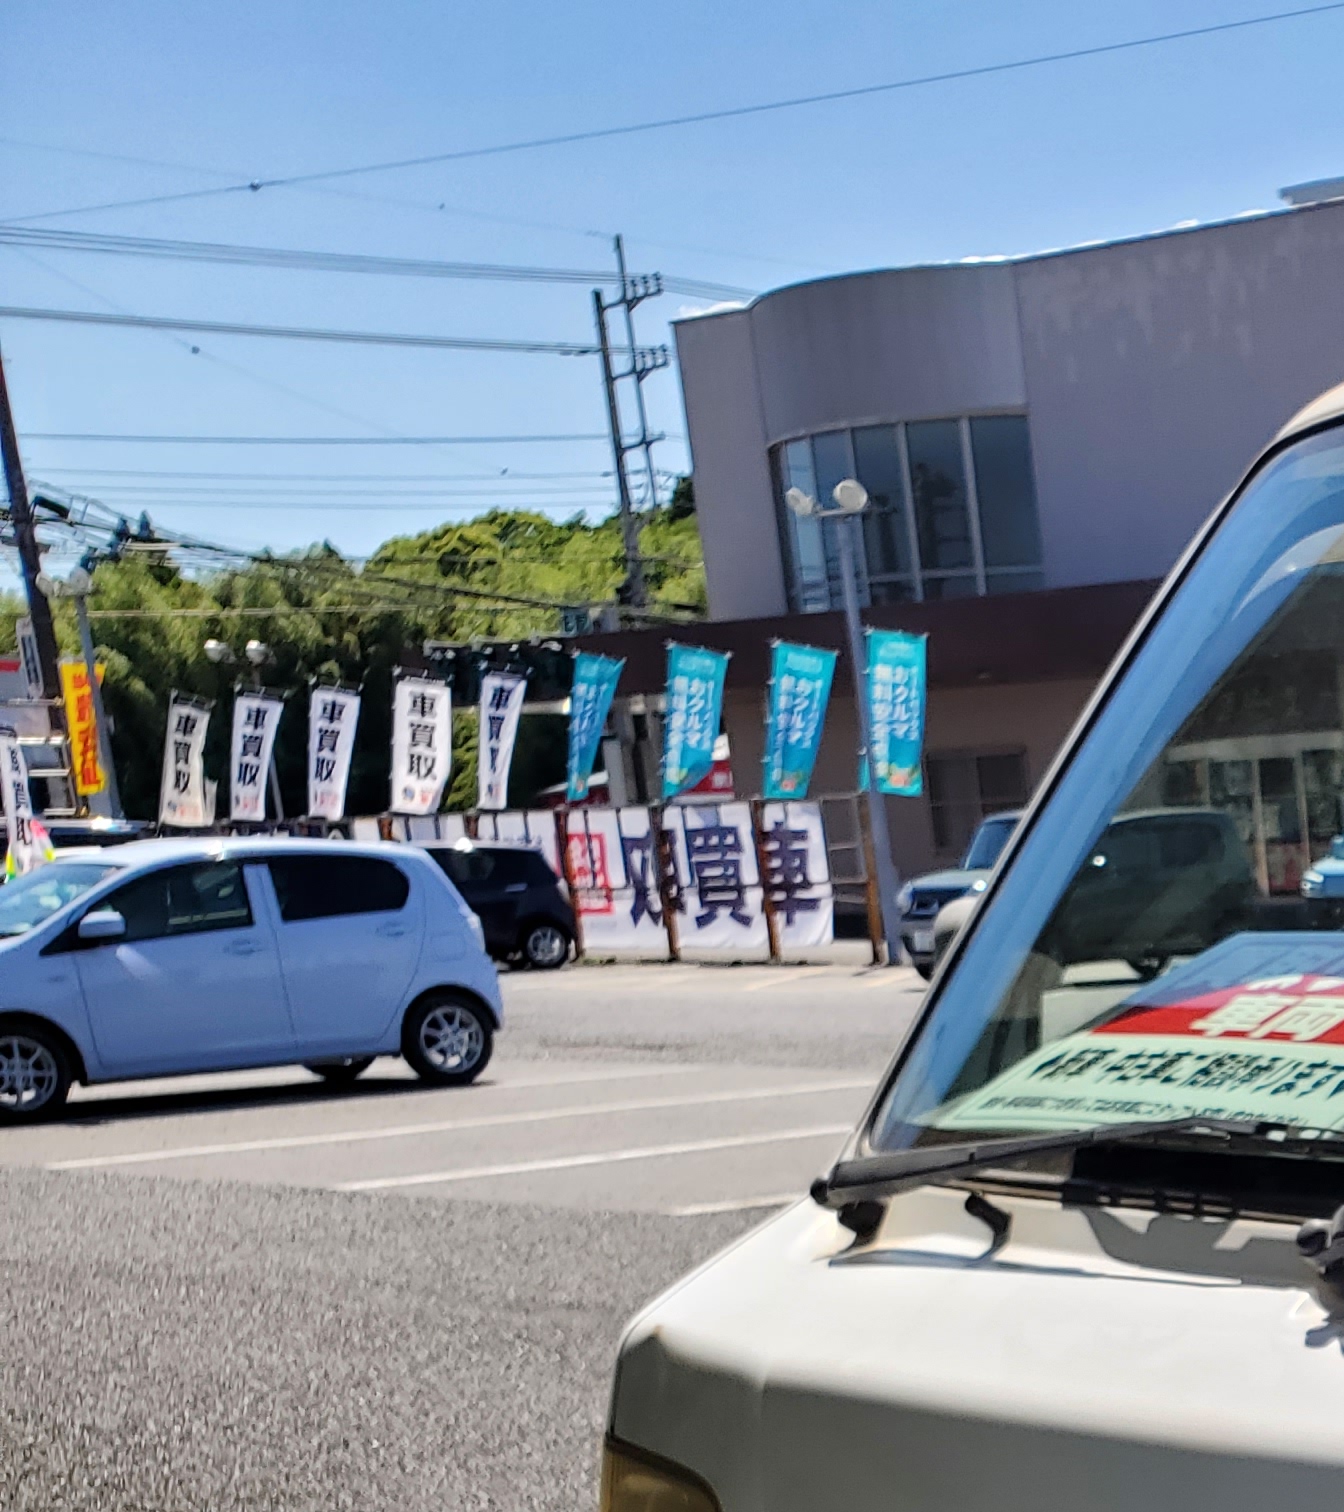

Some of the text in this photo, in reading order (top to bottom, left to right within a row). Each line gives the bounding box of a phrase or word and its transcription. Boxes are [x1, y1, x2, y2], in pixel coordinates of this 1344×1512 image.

[237, 707, 269, 788] 車買取
[314, 700, 346, 783] 車買取
[407, 690, 438, 780] 車買取
